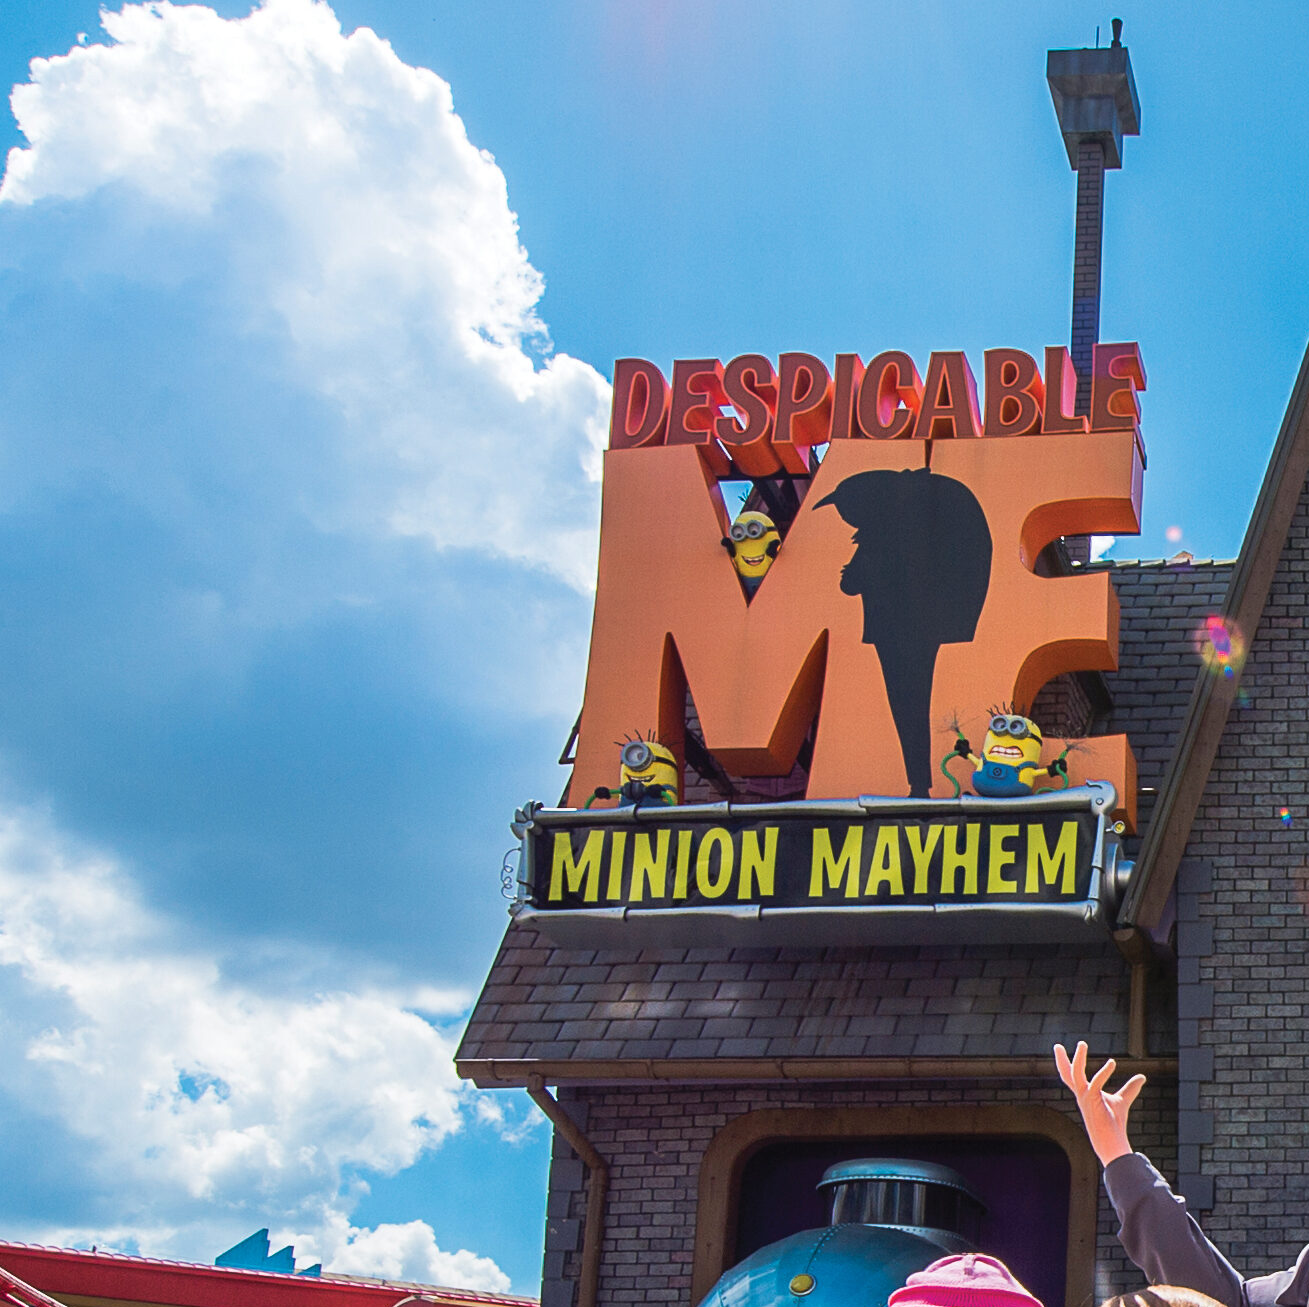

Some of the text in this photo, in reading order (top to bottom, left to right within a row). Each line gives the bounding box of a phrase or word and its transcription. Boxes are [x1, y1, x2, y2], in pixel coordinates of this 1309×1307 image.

[608, 342, 1146, 450] DESPICABLE
[566, 431, 1147, 815] ME
[548, 821, 1078, 902] MINION MAYHEM
